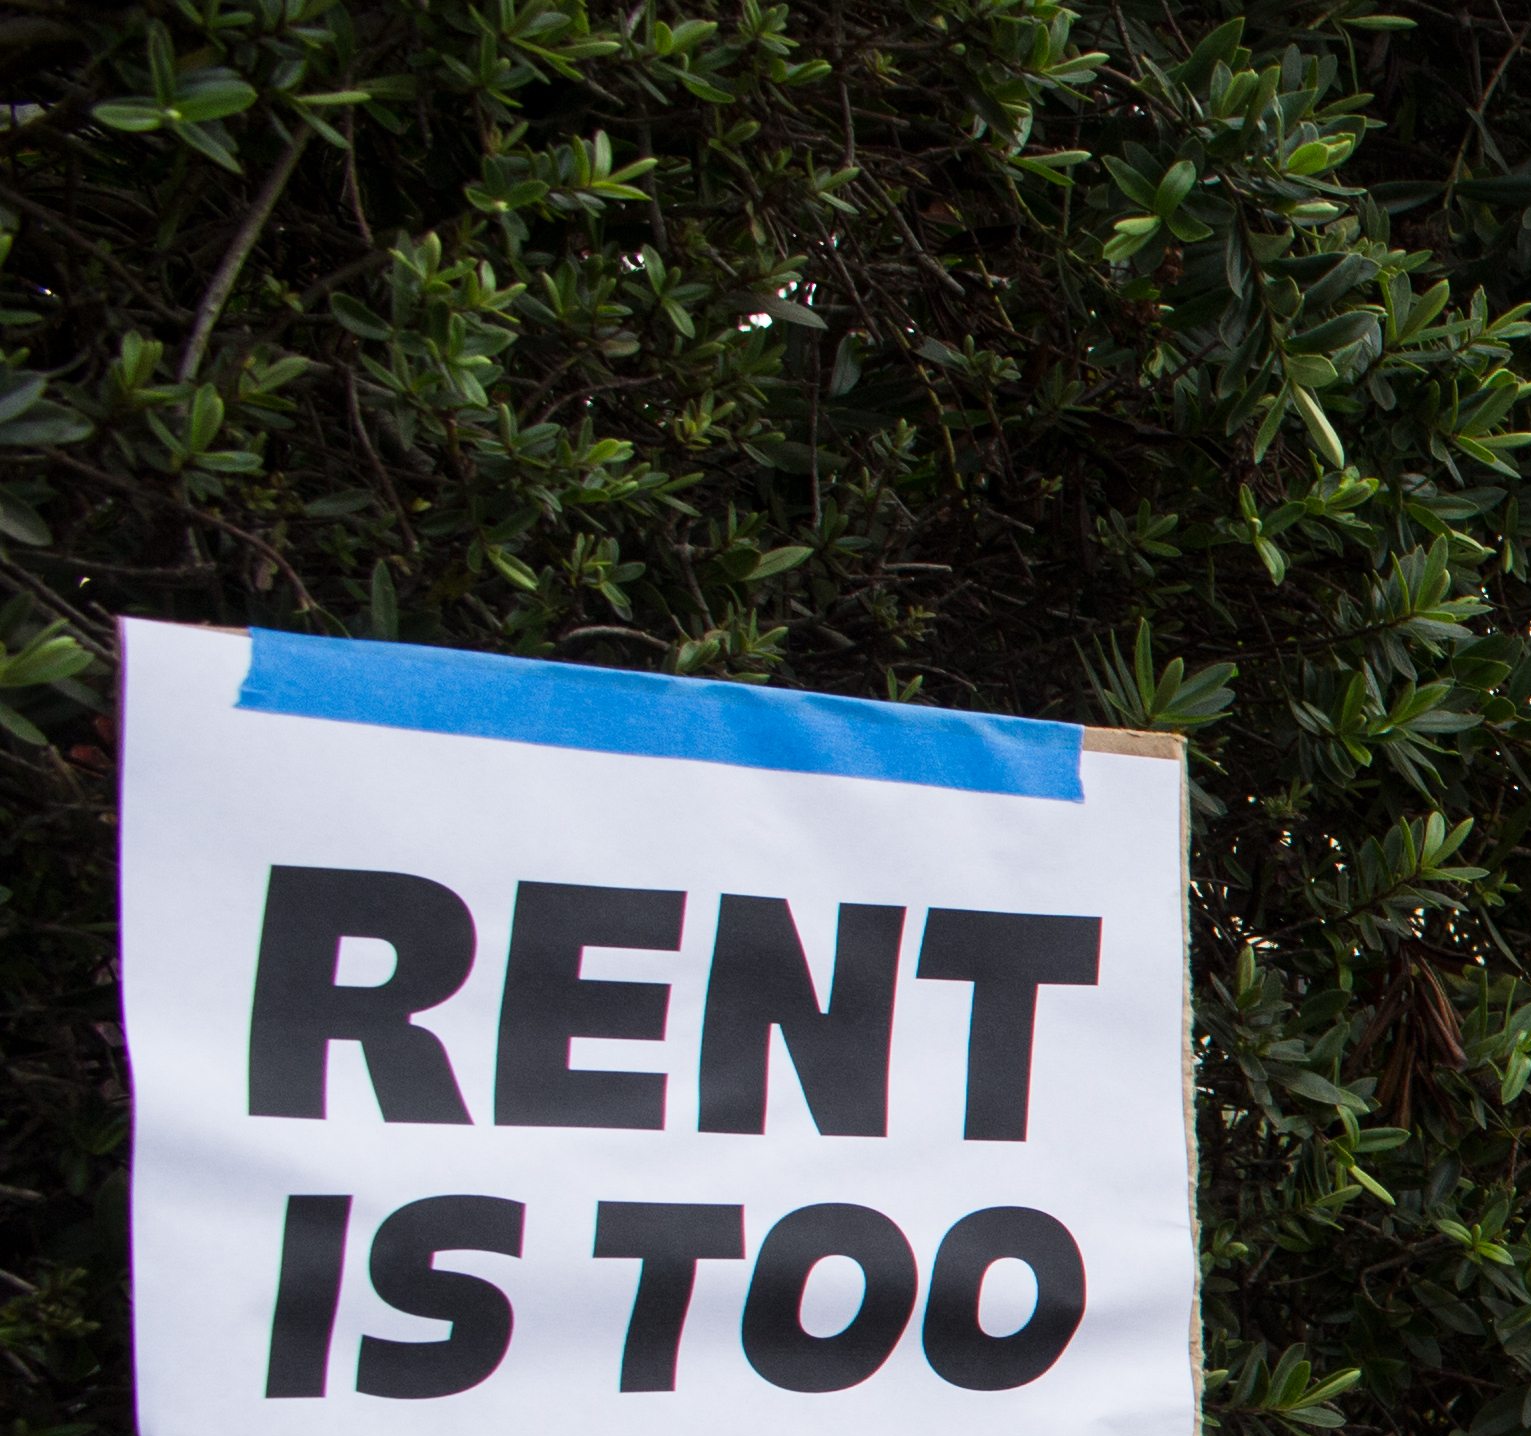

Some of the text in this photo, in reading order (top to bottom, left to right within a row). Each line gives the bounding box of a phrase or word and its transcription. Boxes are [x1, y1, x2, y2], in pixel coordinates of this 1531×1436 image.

[248, 864, 1102, 1141] RENT
[264, 1193, 1087, 1399] IS TOO
